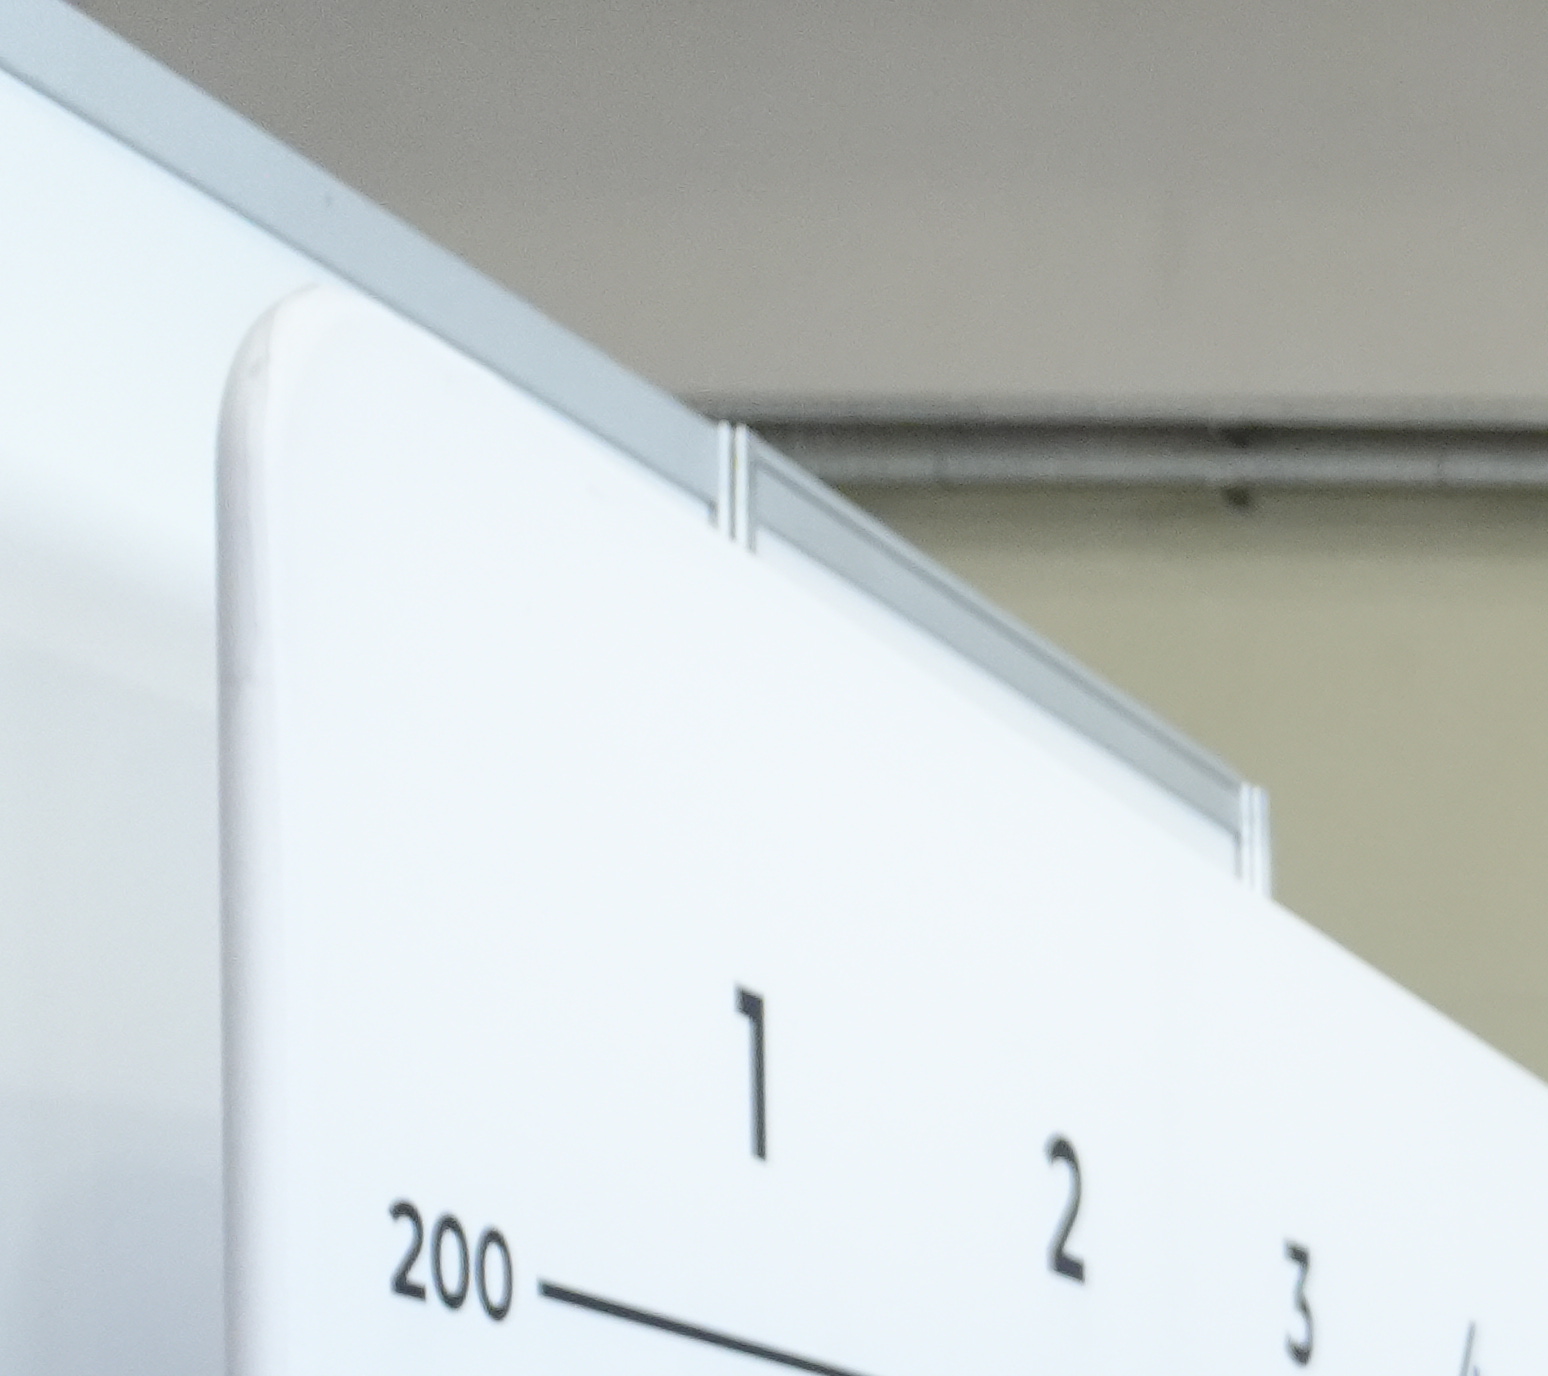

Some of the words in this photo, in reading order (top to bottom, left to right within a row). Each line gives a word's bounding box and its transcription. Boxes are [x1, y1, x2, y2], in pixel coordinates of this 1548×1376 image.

[388, 1199, 514, 1323] 200
[734, 986, 768, 1162] 1
[1046, 1135, 1087, 1285] 2
[1285, 1241, 1314, 1369] 3
